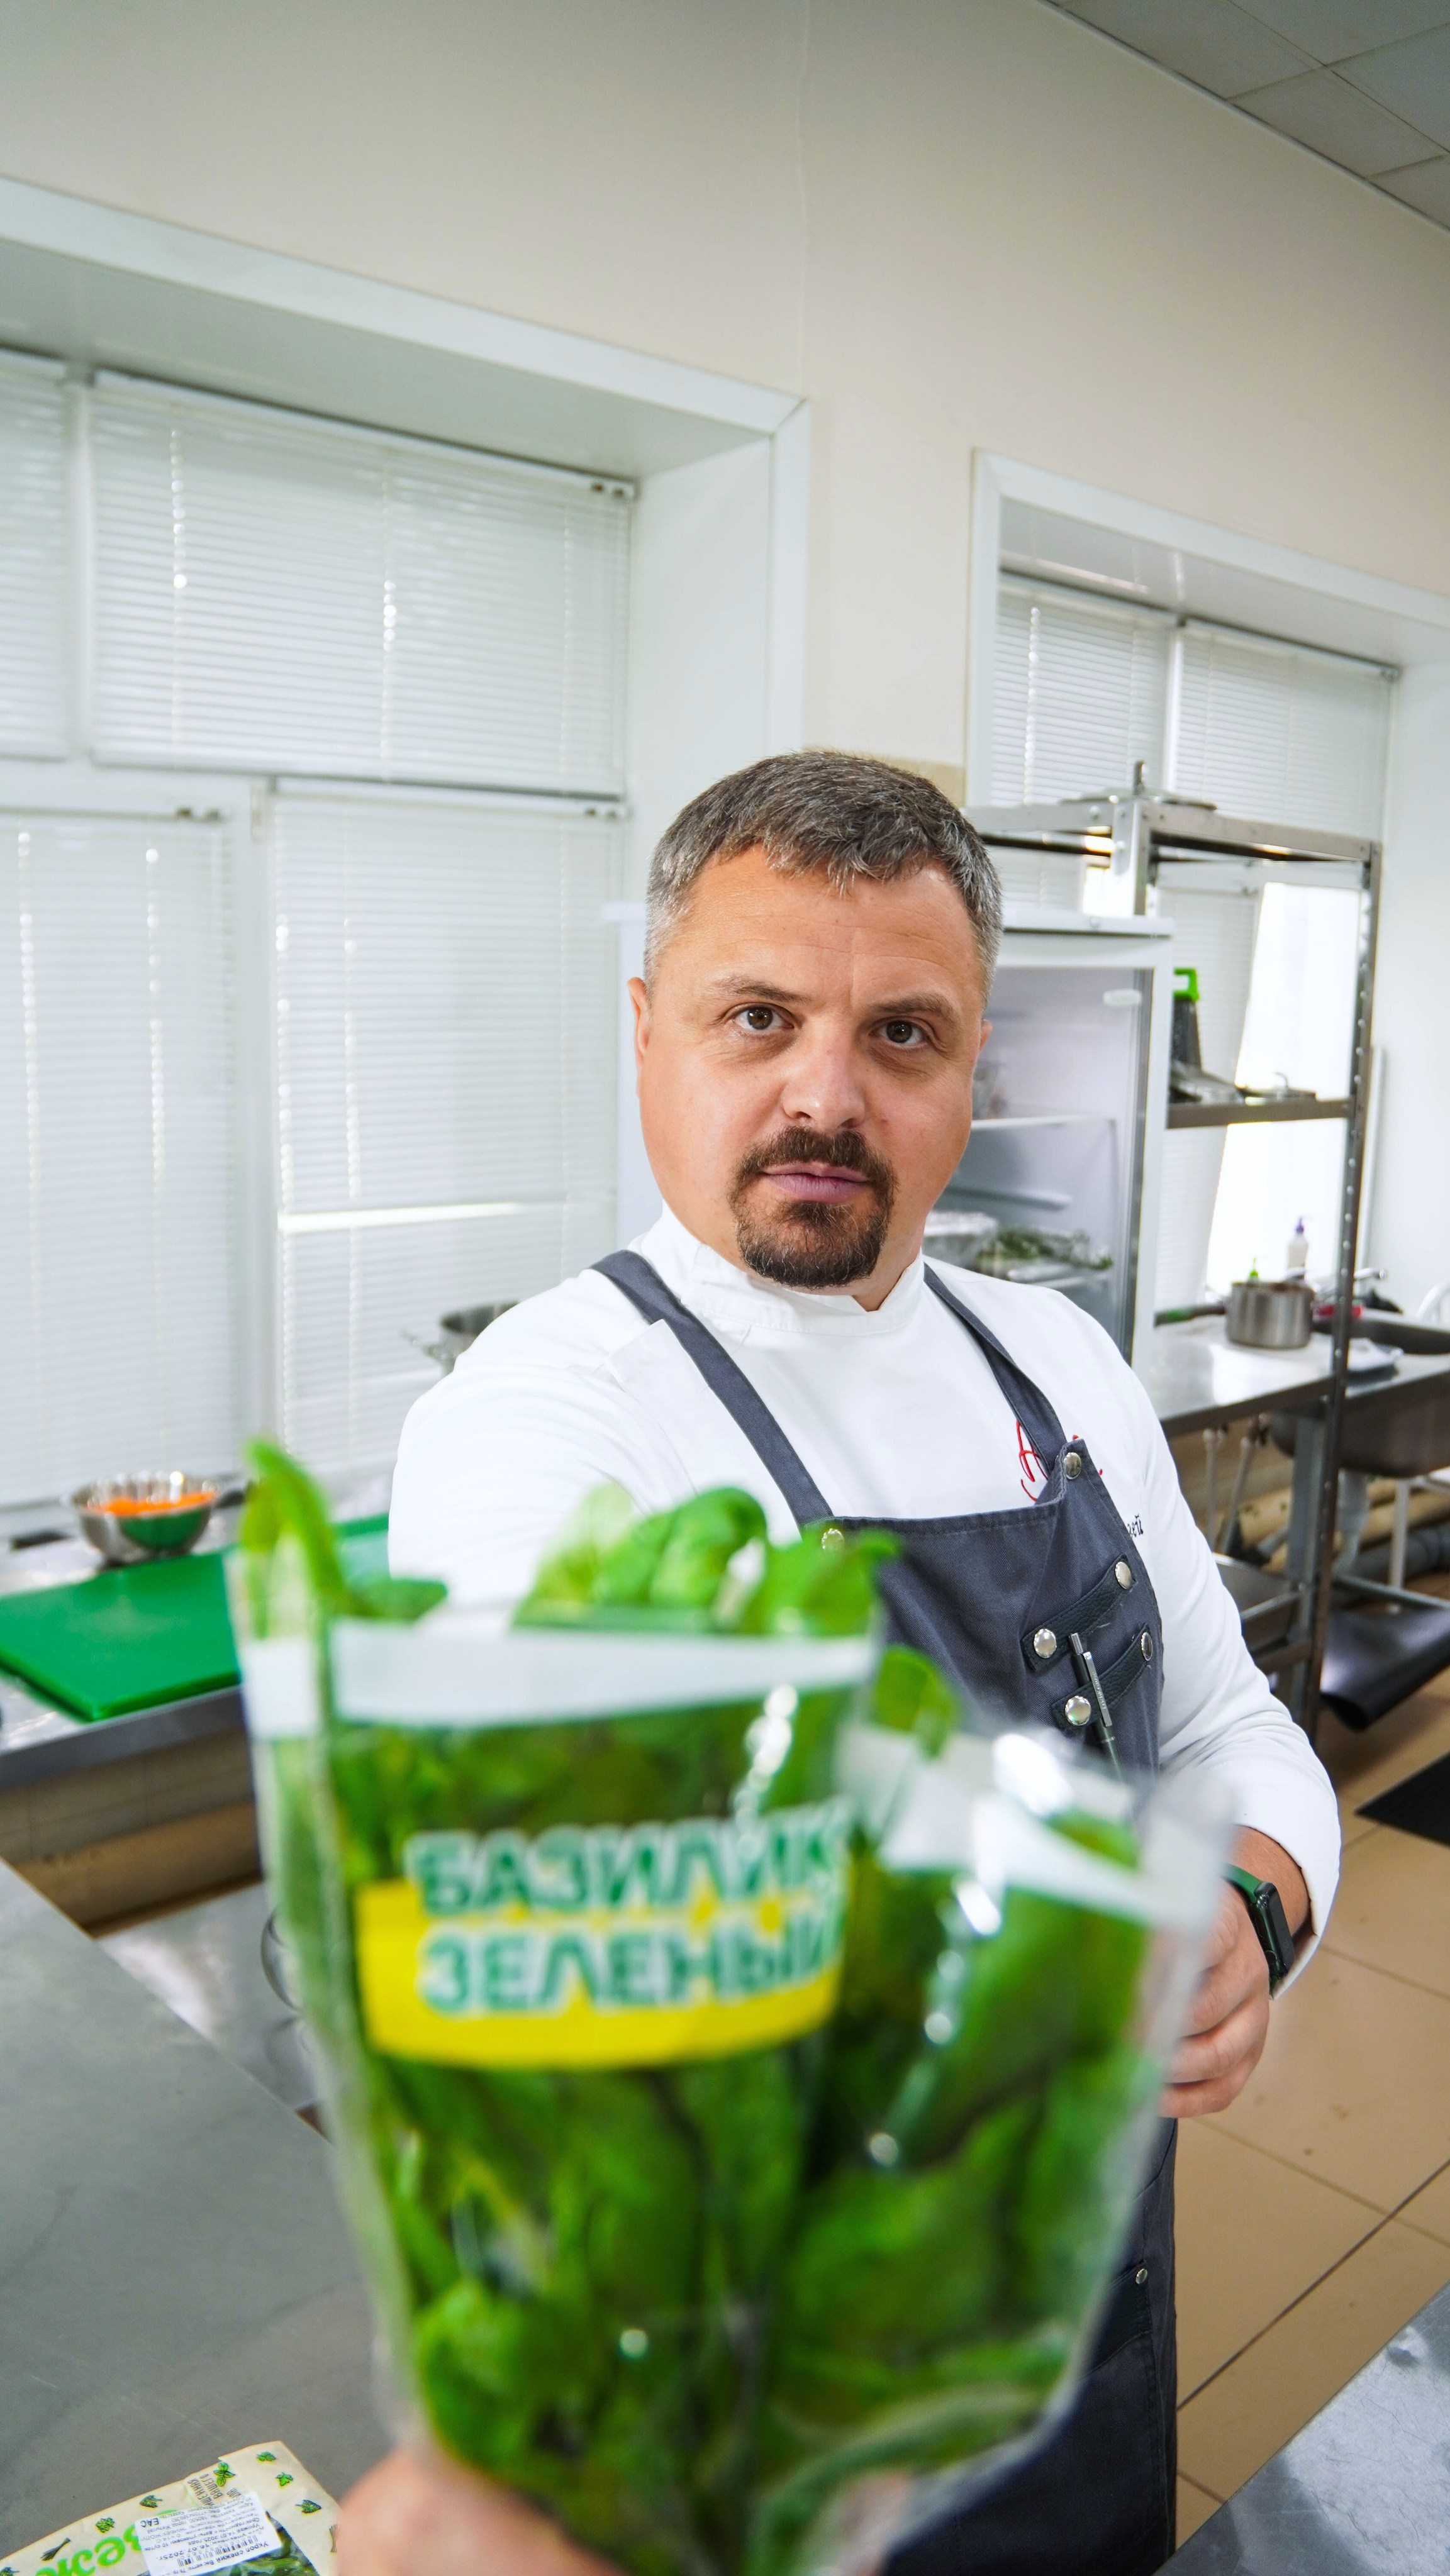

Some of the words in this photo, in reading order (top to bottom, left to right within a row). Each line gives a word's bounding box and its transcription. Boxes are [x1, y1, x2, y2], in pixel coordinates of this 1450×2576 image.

[409, 1797, 850, 1916] БАЗИЛИК
[198, 2472, 223, 2499] ВАШЕГО
[139, 2516, 159, 2529] EAC
[245, 2541, 269, 2553] Укроп
[215, 2550, 243, 2563] свежий
